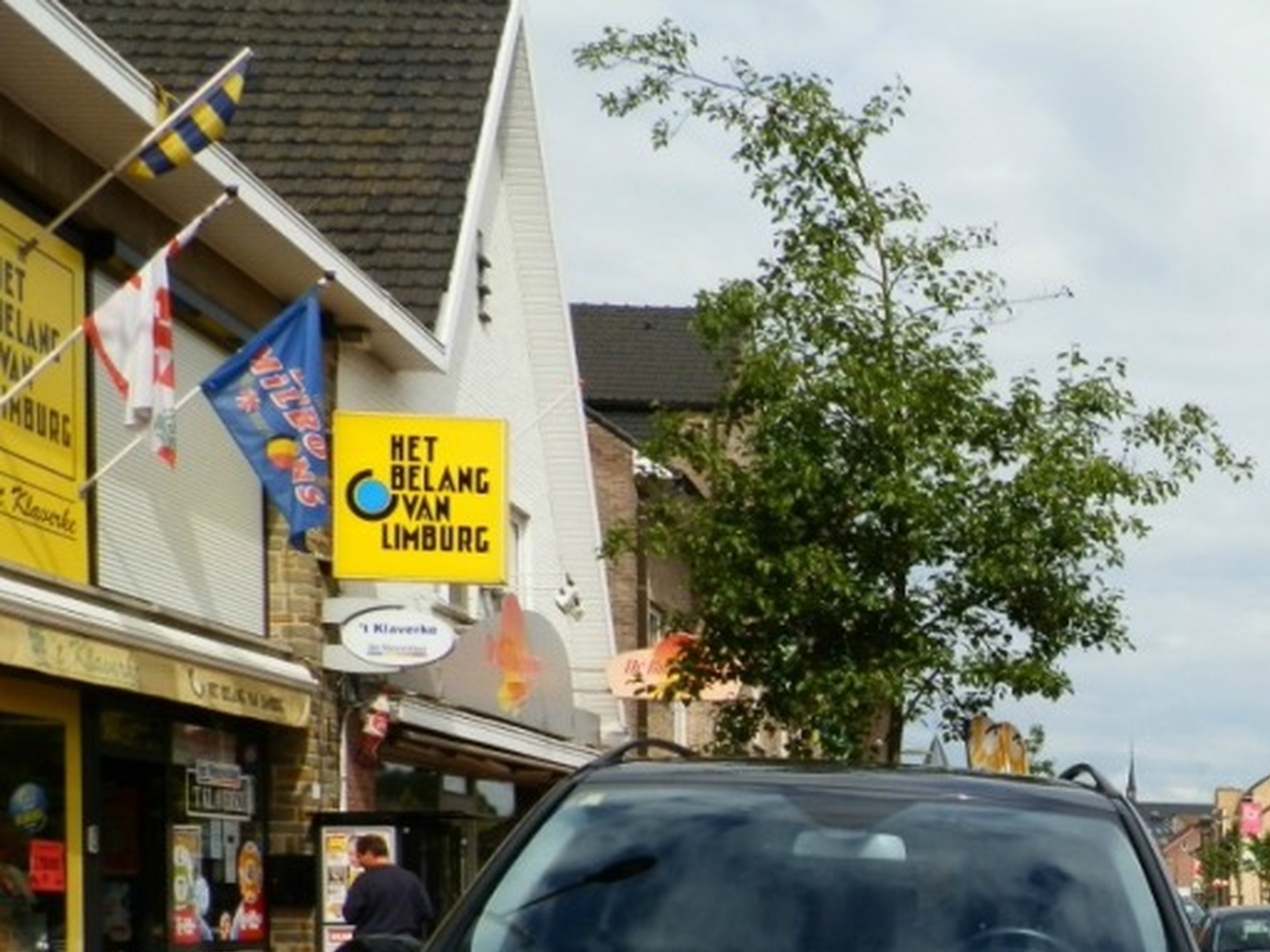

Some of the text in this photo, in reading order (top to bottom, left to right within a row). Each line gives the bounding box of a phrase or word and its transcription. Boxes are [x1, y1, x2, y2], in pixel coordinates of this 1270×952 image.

[0, 259, 26, 303] ET
[391, 434, 438, 463] HET
[391, 464, 489, 494] BELANG
[402, 494, 450, 522] VAN
[381, 522, 489, 553] LIMBURG
